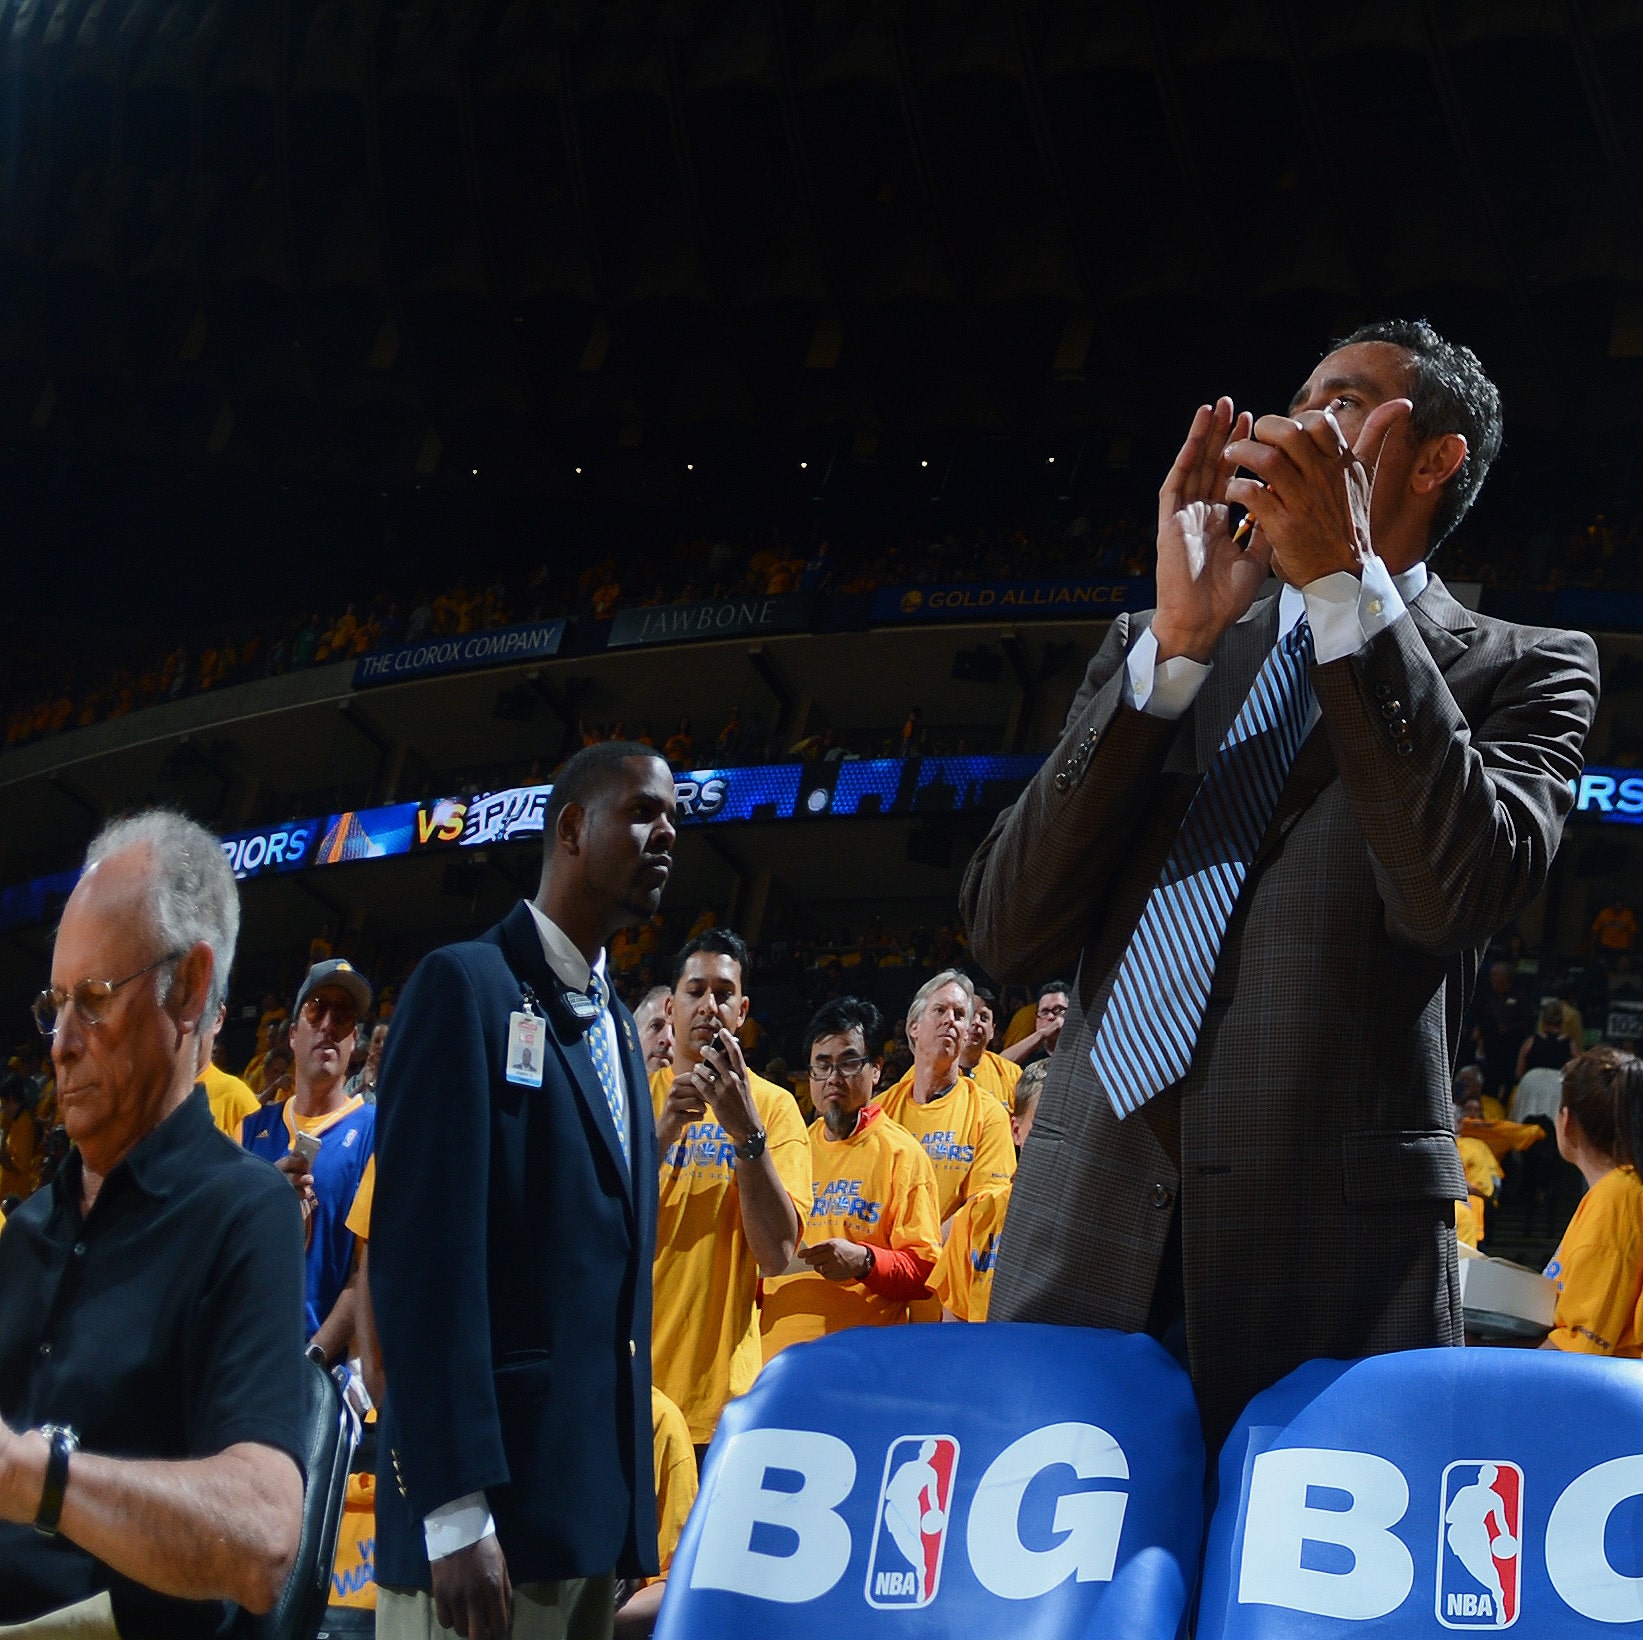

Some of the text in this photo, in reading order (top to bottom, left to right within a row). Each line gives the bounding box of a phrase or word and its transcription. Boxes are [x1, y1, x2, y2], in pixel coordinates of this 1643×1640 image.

[927, 584, 1128, 609] GOLD ALLIANCE
[641, 599, 777, 640] JAWBONE
[362, 625, 557, 678] THE CLOROX COMPANY
[417, 802, 468, 845] VS
[874, 1571, 917, 1598] NBA
[1446, 1592, 1493, 1618] NBA
